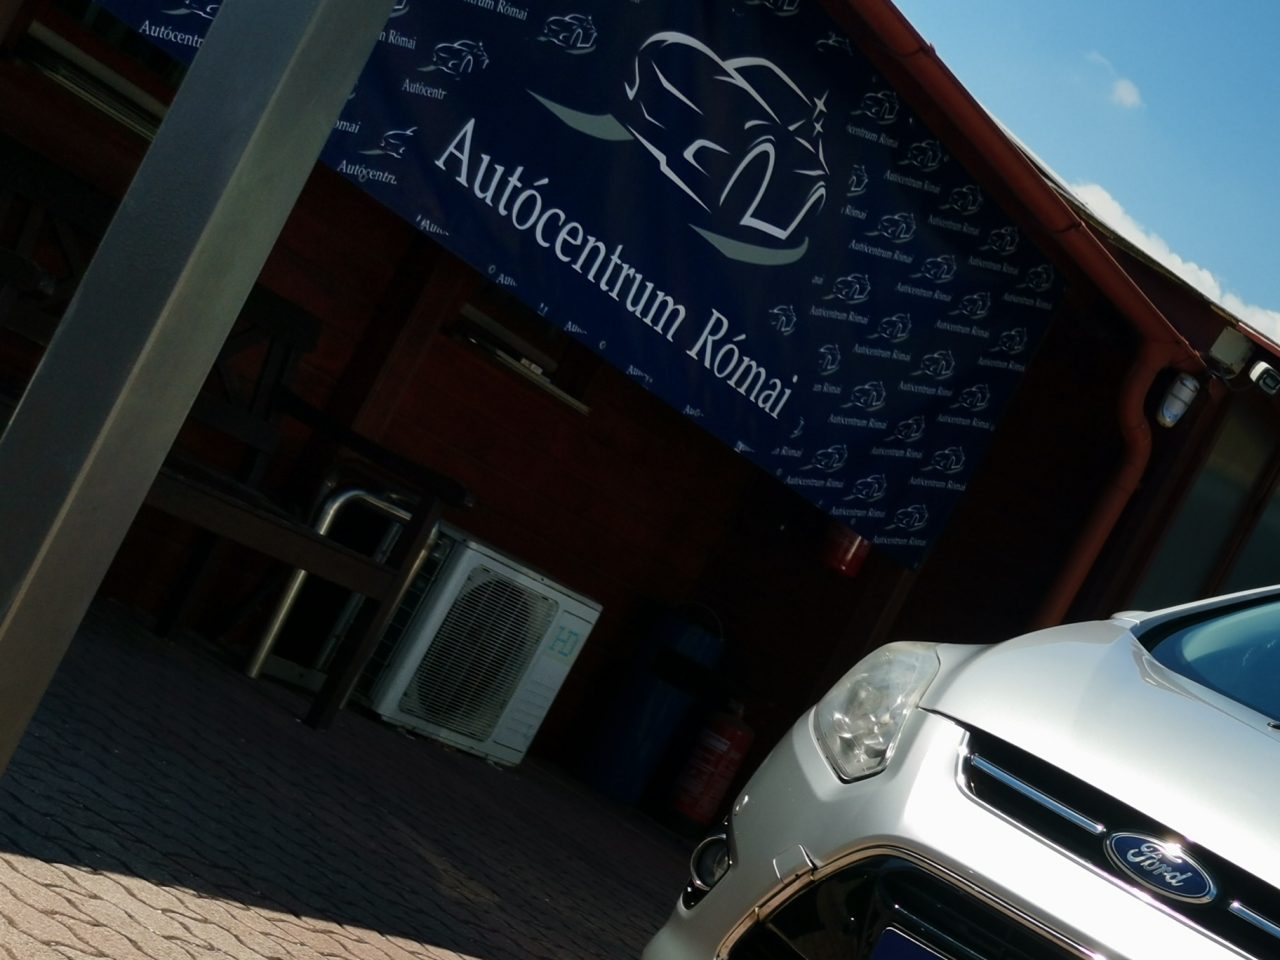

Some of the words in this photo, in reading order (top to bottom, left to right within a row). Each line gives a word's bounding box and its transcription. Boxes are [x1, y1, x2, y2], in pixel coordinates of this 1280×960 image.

[434, 117, 687, 343] Autócentrum
[686, 309, 799, 420] Római
[1126, 842, 1193, 886] Ford
